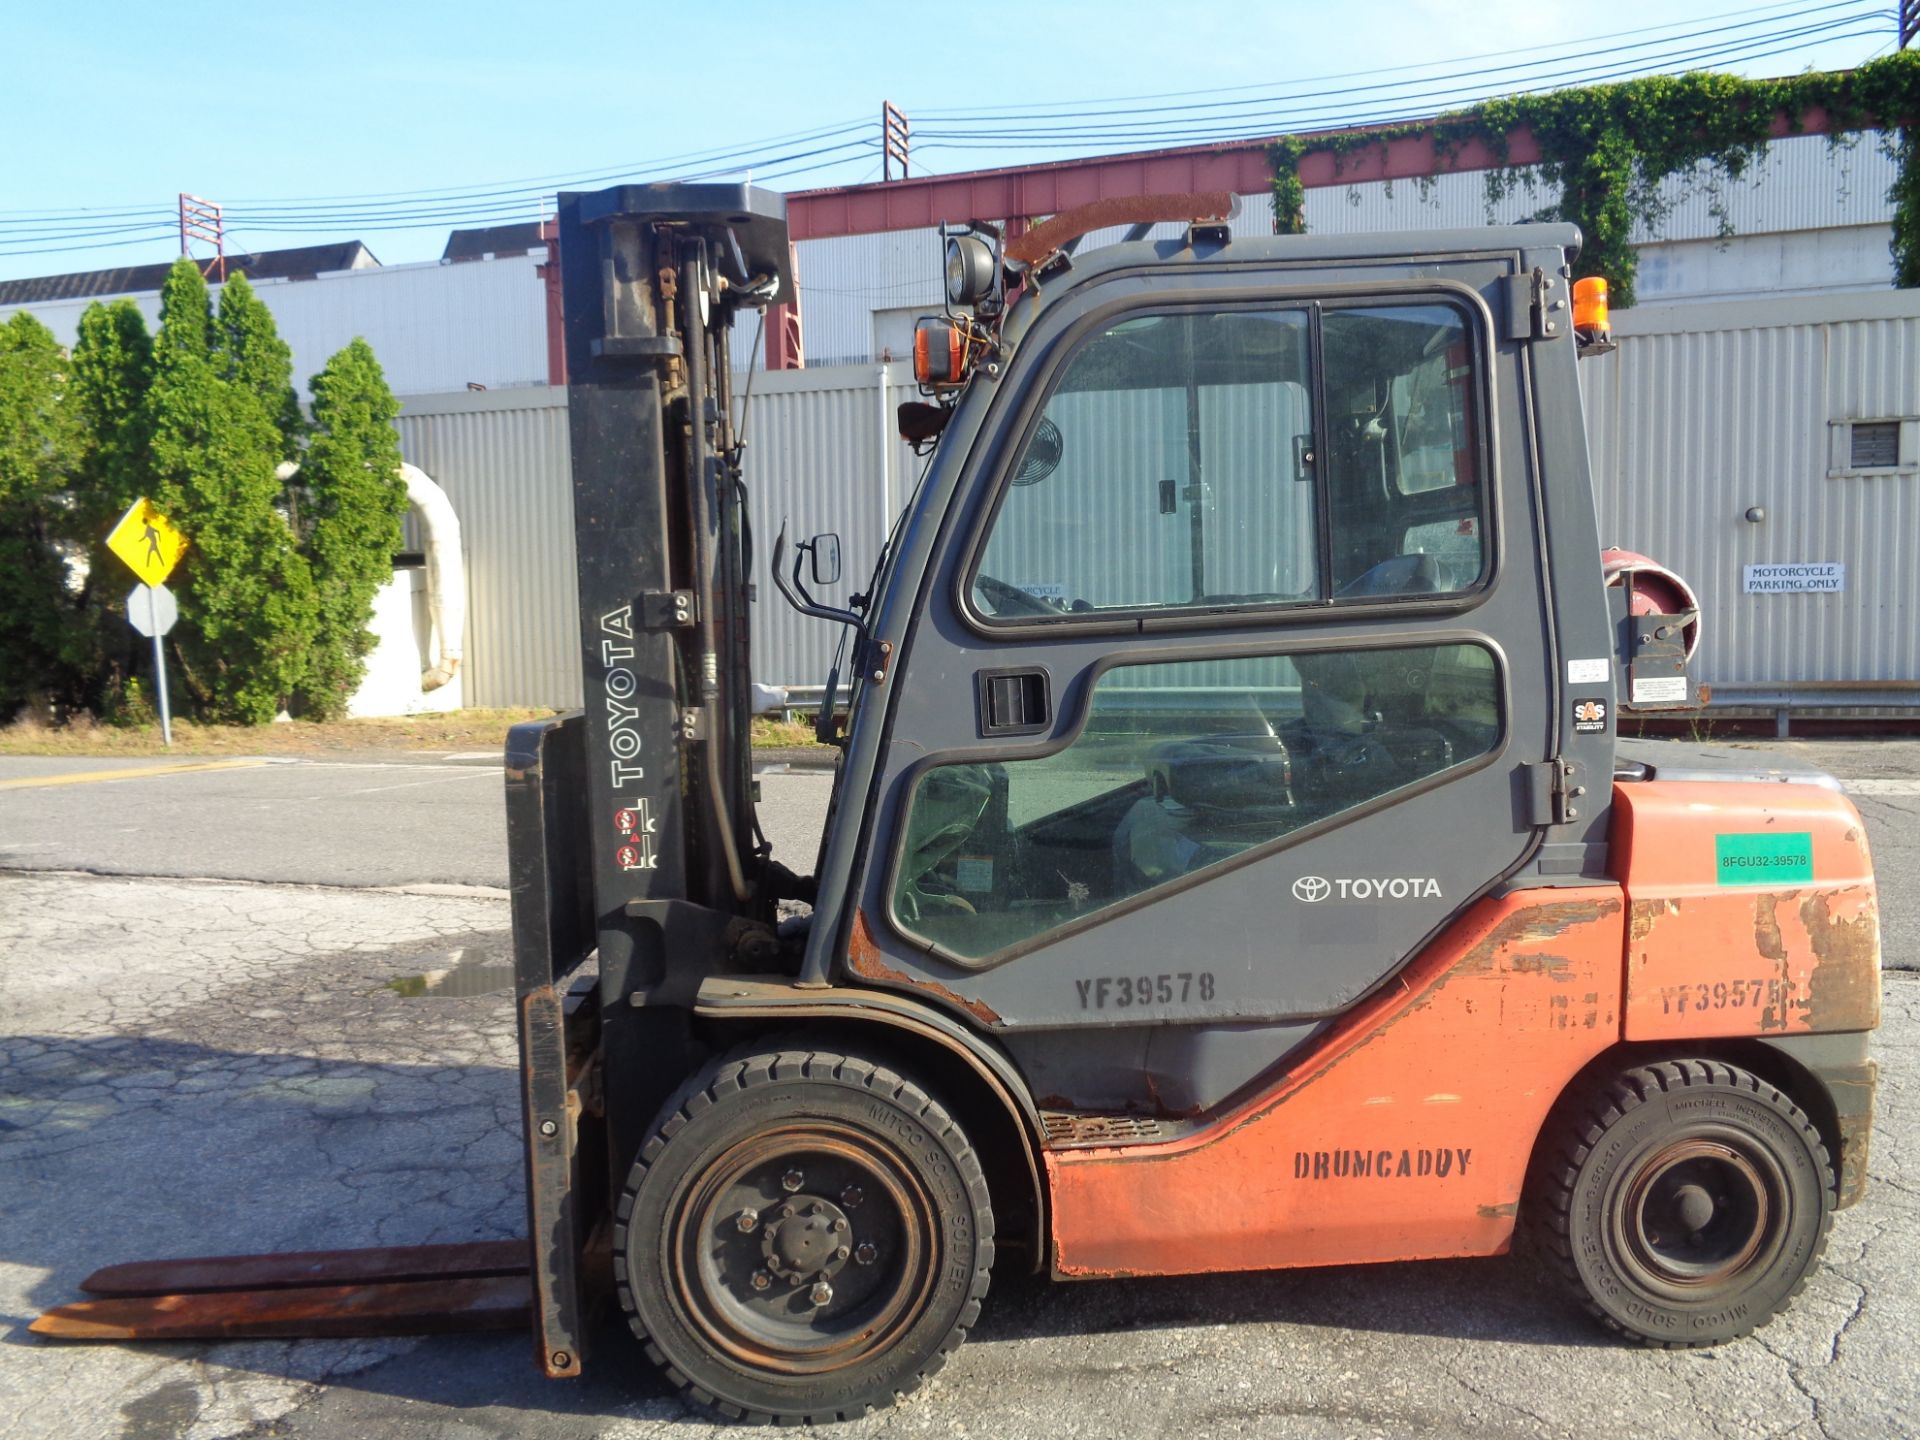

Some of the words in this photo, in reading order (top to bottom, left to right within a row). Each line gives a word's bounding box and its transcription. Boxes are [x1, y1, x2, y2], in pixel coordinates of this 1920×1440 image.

[1748, 579, 1802, 590] PARKING
[1807, 578, 1839, 589] ONLY
[1752, 566, 1835, 578] MOTORCYCLE
[600, 604, 644, 788] TOYOTA
[1575, 702, 1605, 721] SAS
[1722, 855, 1807, 867] 8FGU32-39578
[1335, 878, 1443, 899] TOYOTA
[1075, 972, 1216, 1009] YF39578
[868, 1103, 923, 1147] MITCO
[1294, 1148, 1472, 1179] DRUMCADDY
[1626, 1302, 1677, 1329] SOLID
